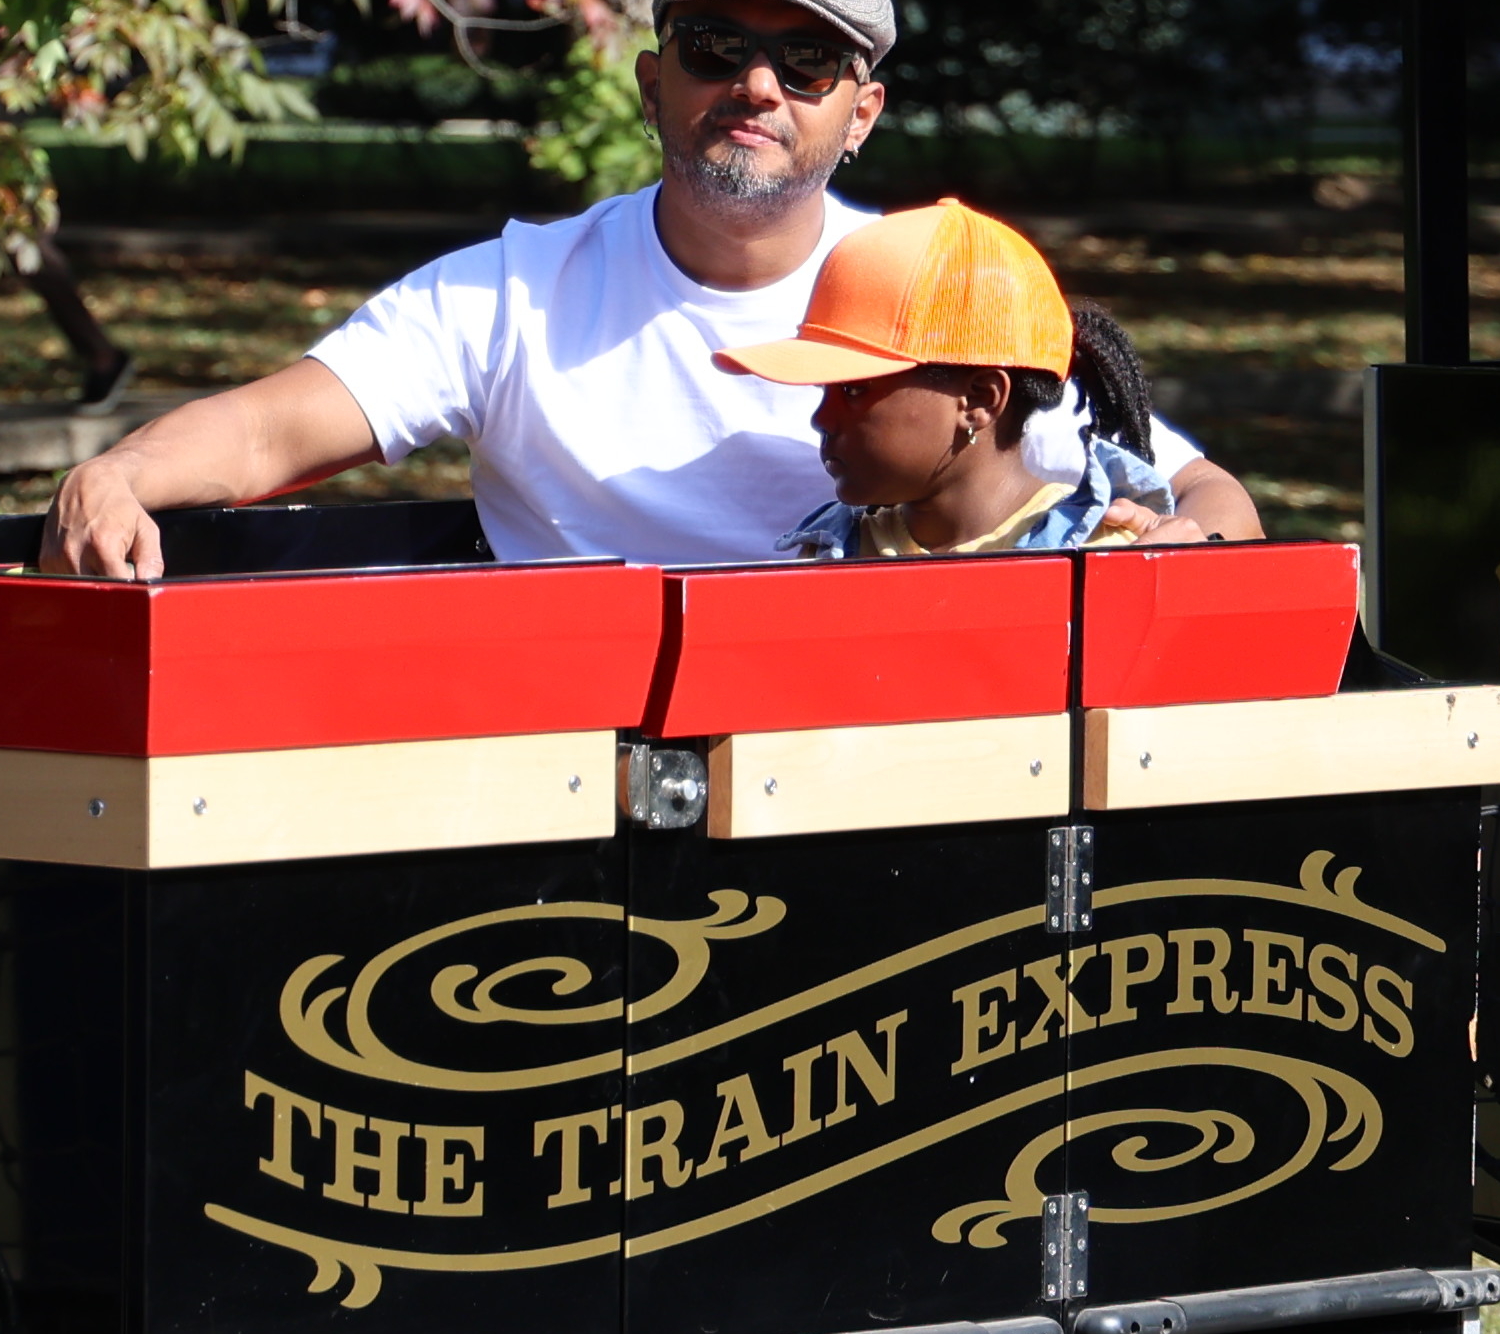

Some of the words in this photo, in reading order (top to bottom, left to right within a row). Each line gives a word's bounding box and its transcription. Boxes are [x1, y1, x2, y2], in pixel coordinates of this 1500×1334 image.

[243, 1069, 484, 1217] THE
[532, 1010, 909, 1210] TRAIN
[951, 927, 1415, 1078] EXPRESS
